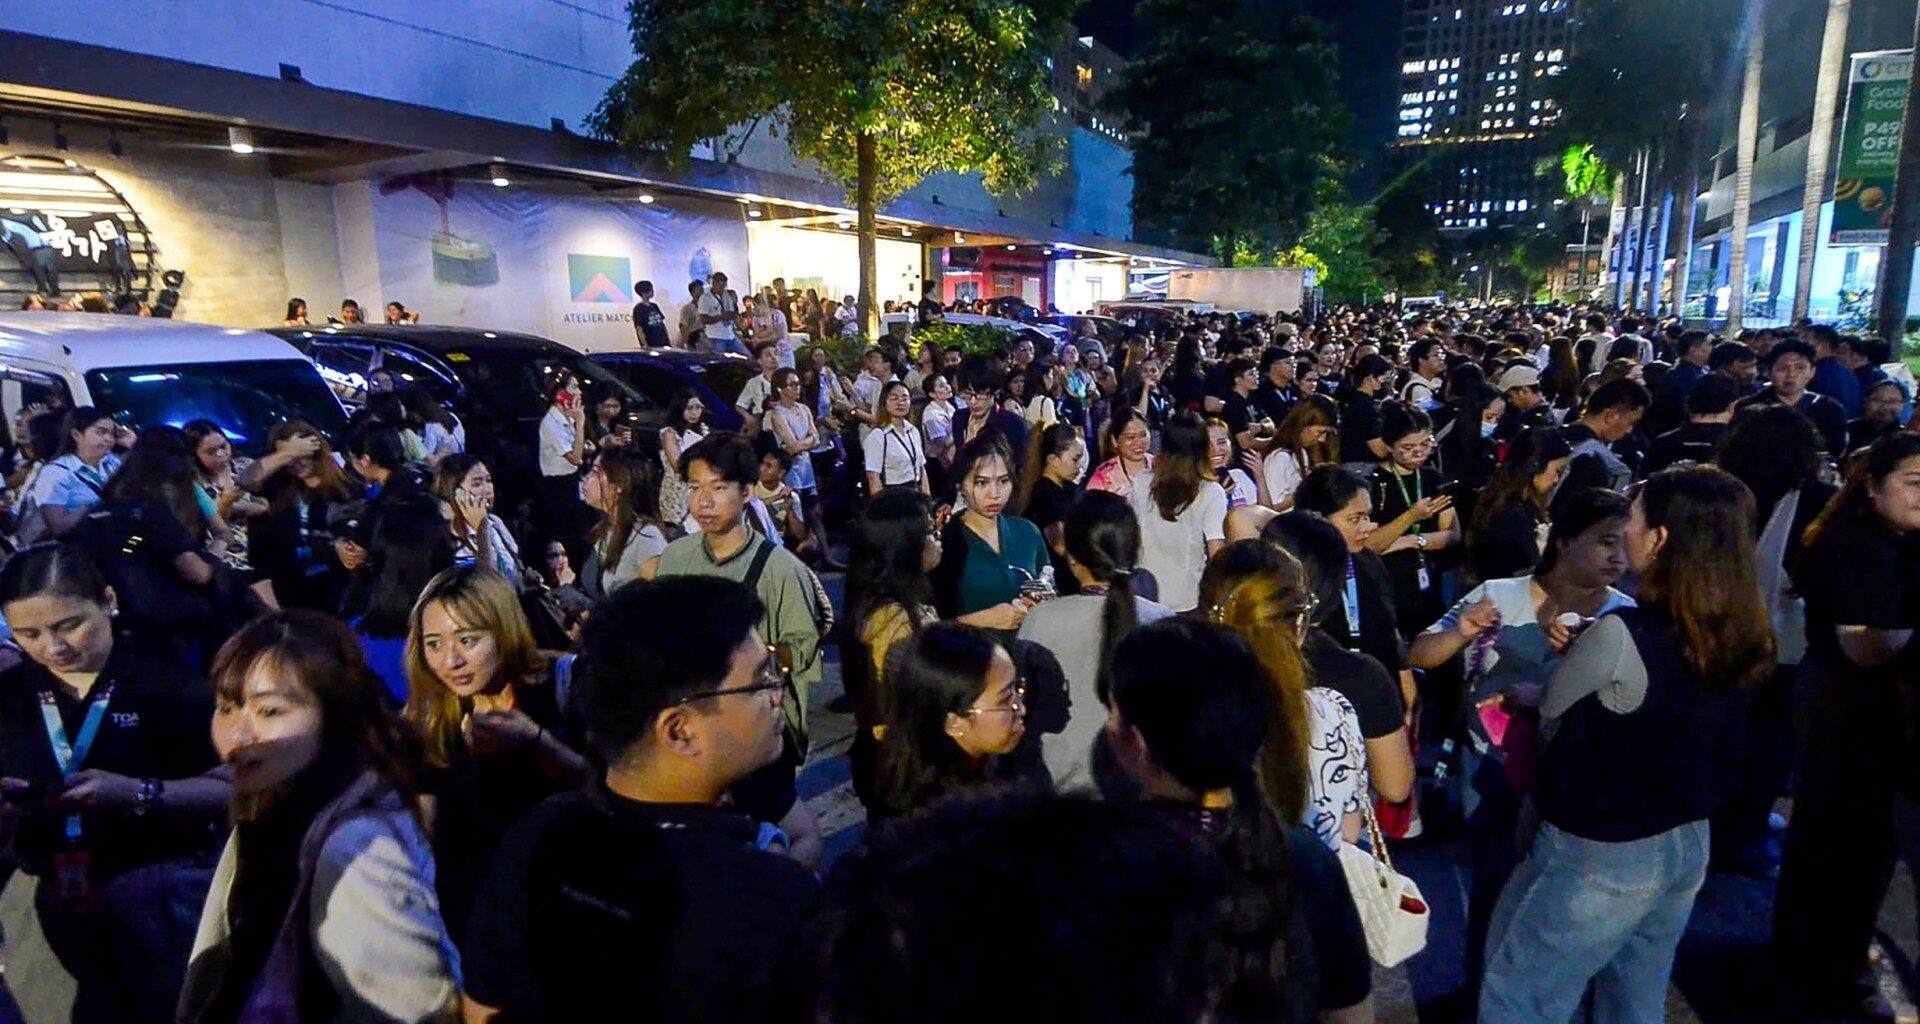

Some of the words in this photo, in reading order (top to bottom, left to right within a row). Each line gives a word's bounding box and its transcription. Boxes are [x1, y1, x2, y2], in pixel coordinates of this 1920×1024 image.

[1862, 136, 1898, 150] OFF
[564, 313, 604, 323] ATELIER
[606, 313, 631, 322] MATC
